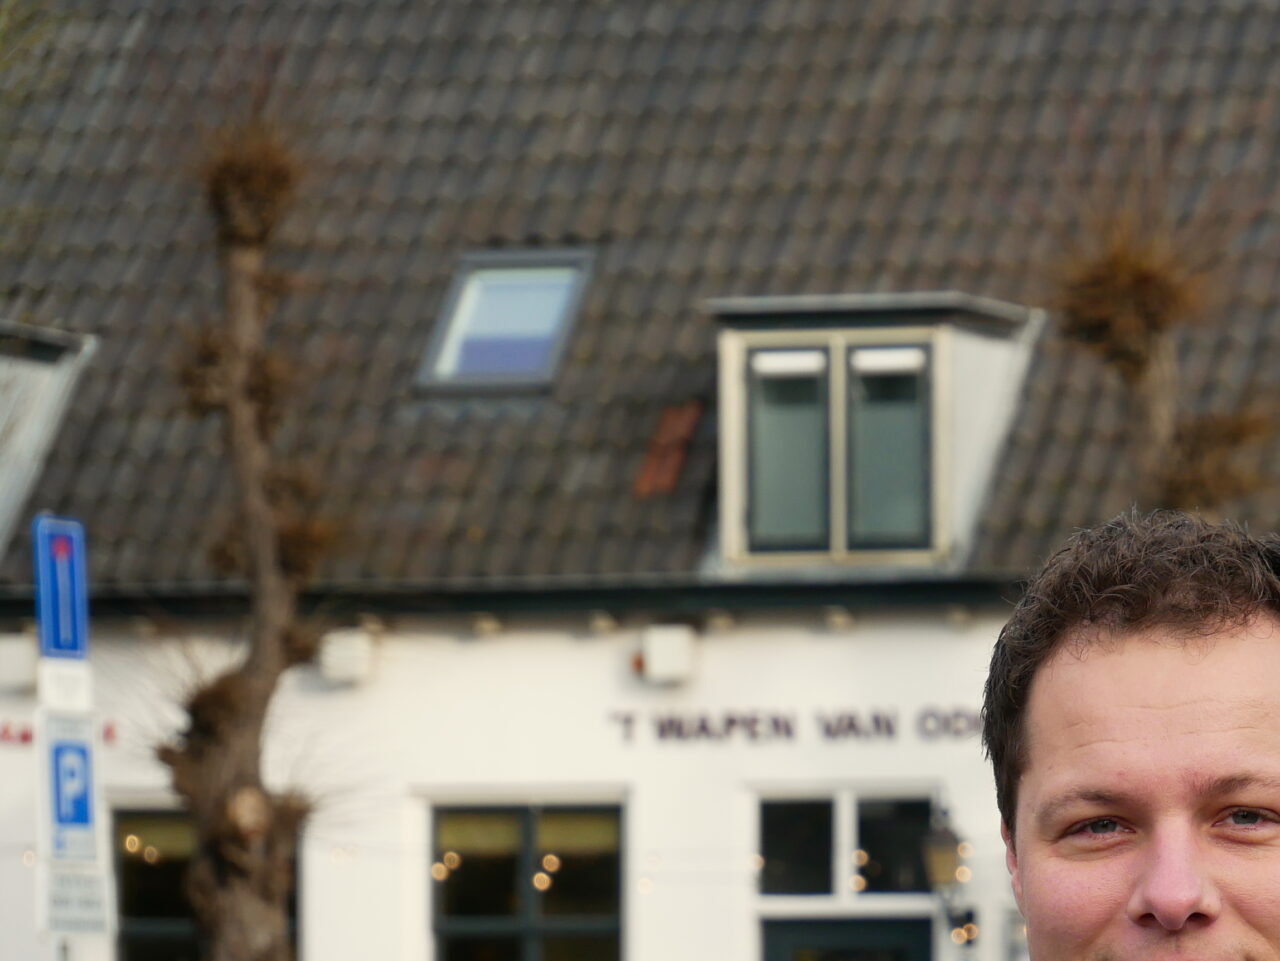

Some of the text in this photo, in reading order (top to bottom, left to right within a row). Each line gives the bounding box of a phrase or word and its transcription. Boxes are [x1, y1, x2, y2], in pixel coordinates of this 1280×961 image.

[654, 711, 797, 743] WAPEN
[816, 709, 897, 741] VAN
[914, 707, 985, 741] OO
